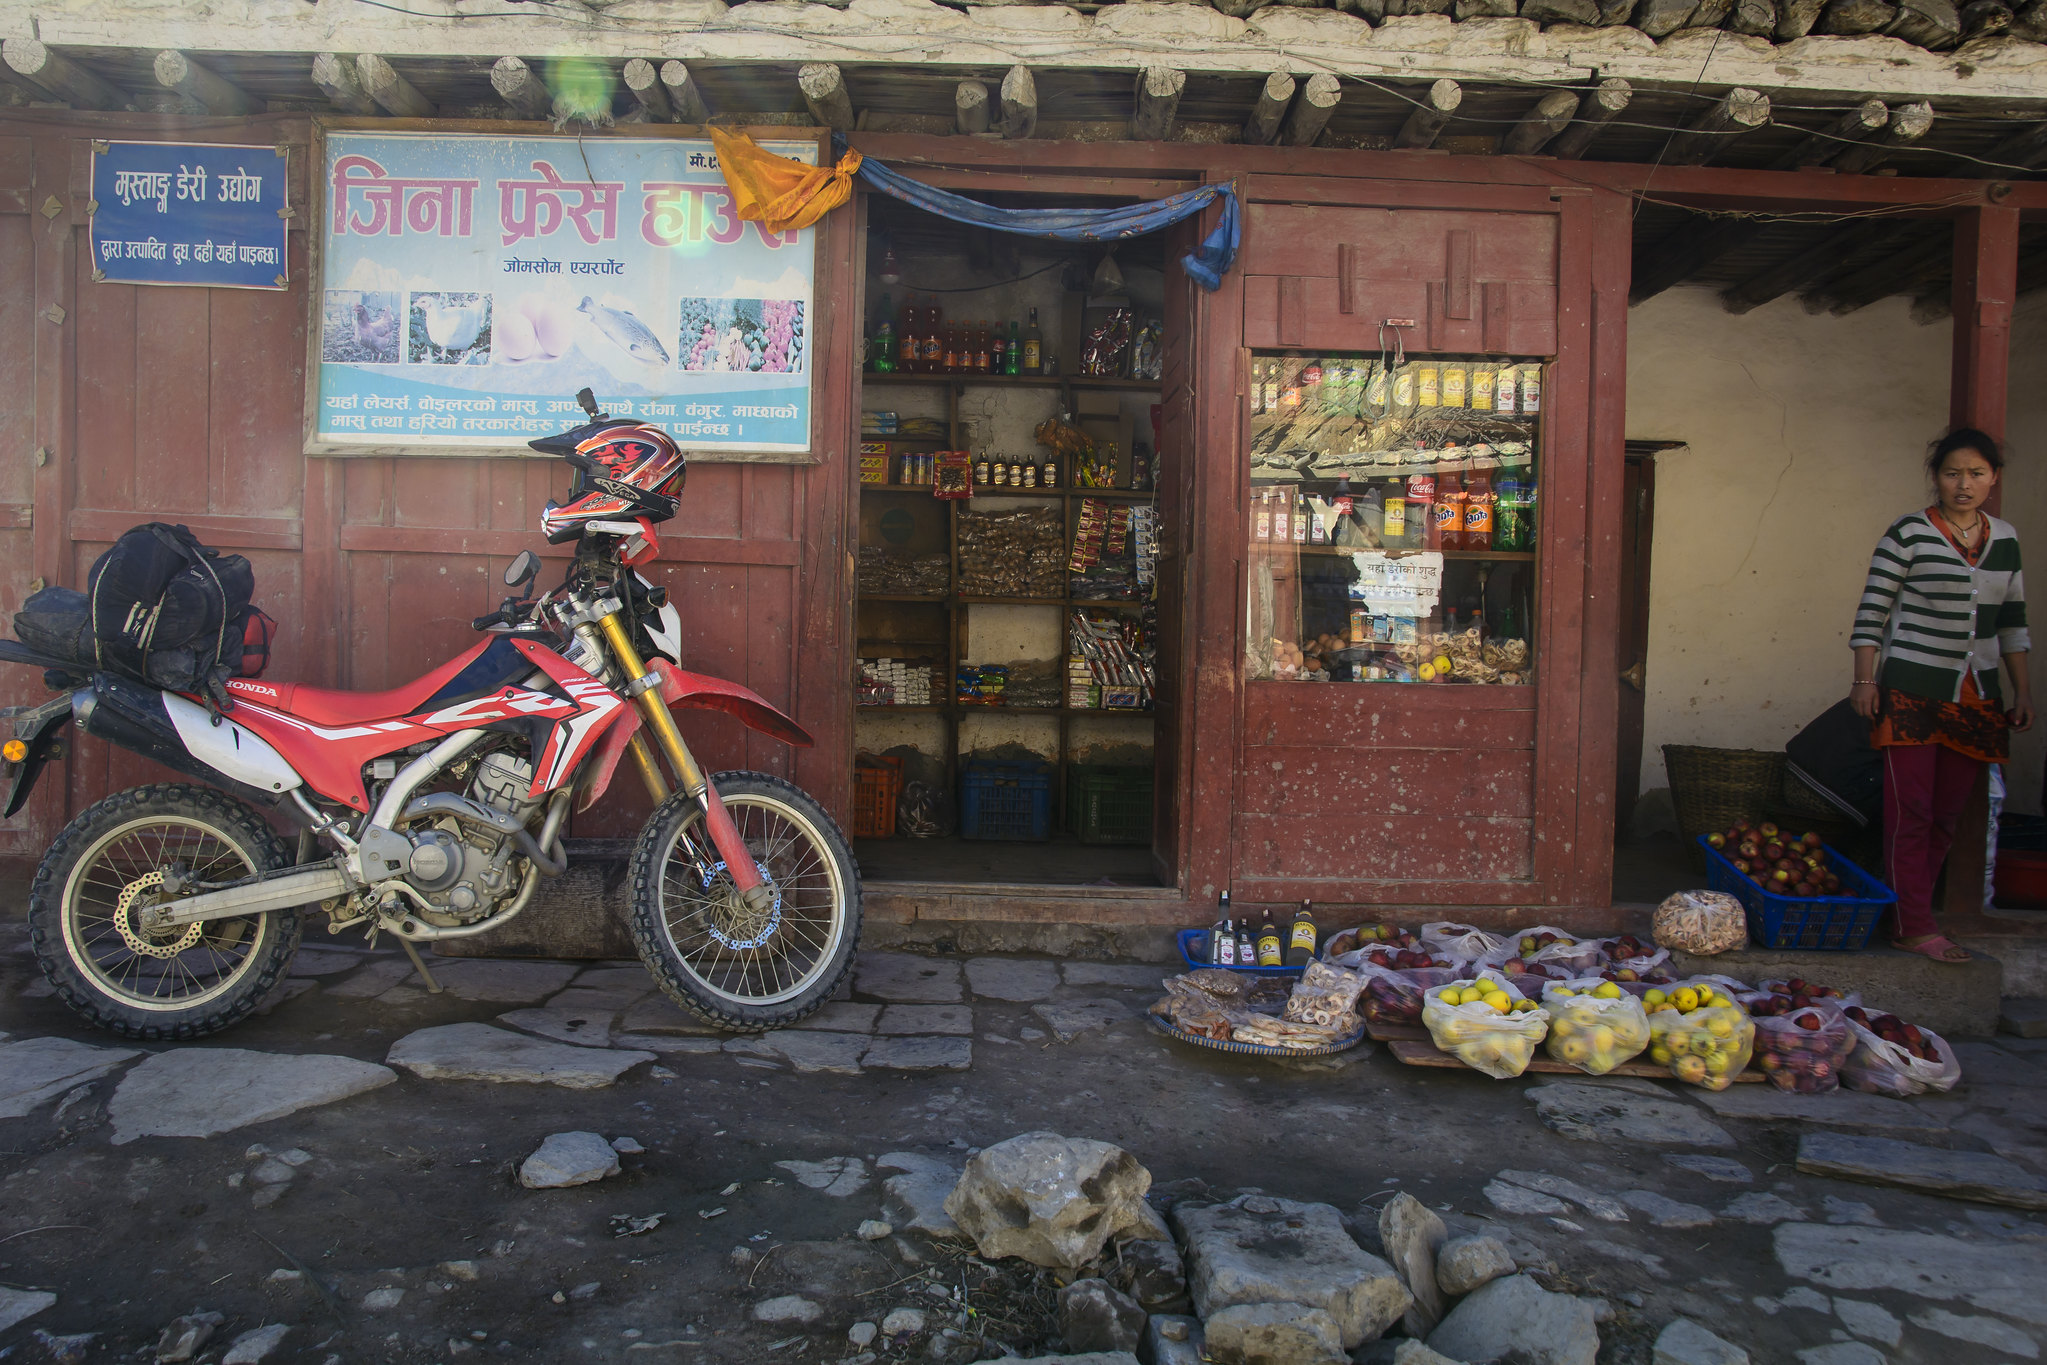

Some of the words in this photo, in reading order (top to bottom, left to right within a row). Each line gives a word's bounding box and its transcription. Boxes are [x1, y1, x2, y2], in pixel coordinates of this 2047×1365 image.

[176, 164, 207, 202] डेरी
[217, 166, 262, 202] उद्योग
[330, 154, 480, 237] जिना
[496, 160, 625, 247] फ्रेस
[125, 236, 167, 260] उत्पादित
[194, 239, 213, 262] दही
[216, 240, 237, 263] यहाँ
[331, 415, 366, 430] मासु
[370, 415, 404, 428] तथा
[408, 413, 458, 430] हरियो
